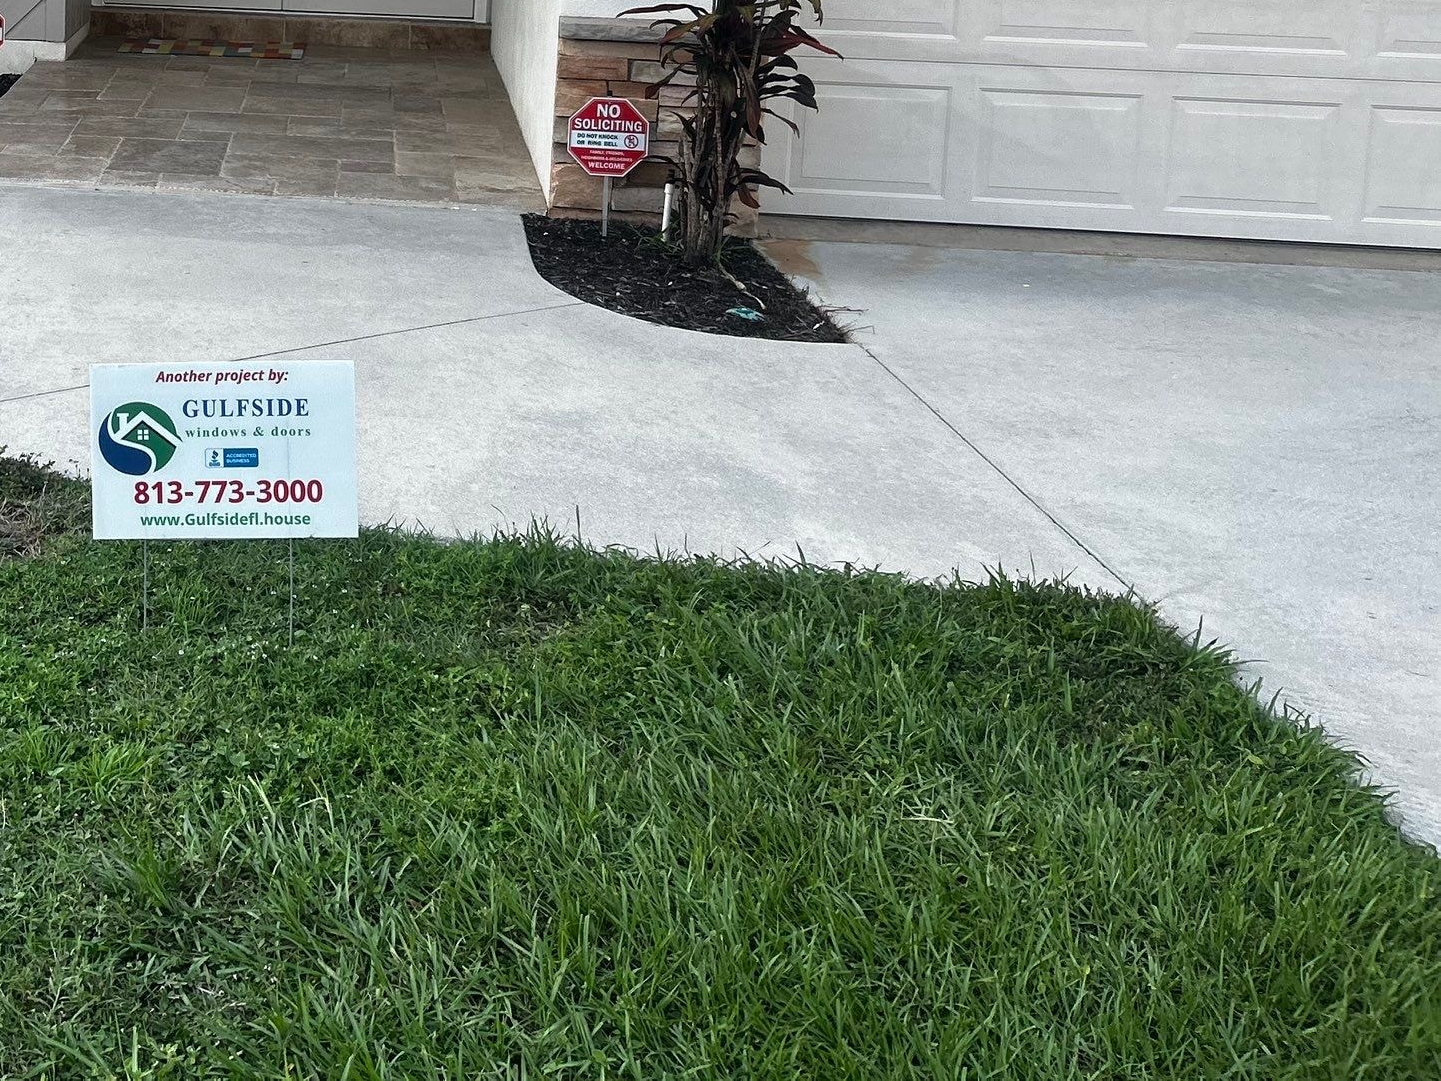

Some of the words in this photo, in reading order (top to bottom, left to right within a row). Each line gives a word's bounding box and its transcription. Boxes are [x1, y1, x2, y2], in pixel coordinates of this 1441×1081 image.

[596, 103, 621, 118] NO
[574, 118, 643, 132] SOLICITING
[155, 369, 212, 383] Another
[214, 369, 265, 385] project
[268, 369, 289, 384] by:
[182, 398, 309, 418] GULFSIDE
[185, 427, 247, 438] windows
[253, 426, 265, 437] &
[271, 426, 311, 437] doors
[134, 479, 323, 504] 813-773-3000
[140, 512, 311, 526] www.Gulfsidefl.house
